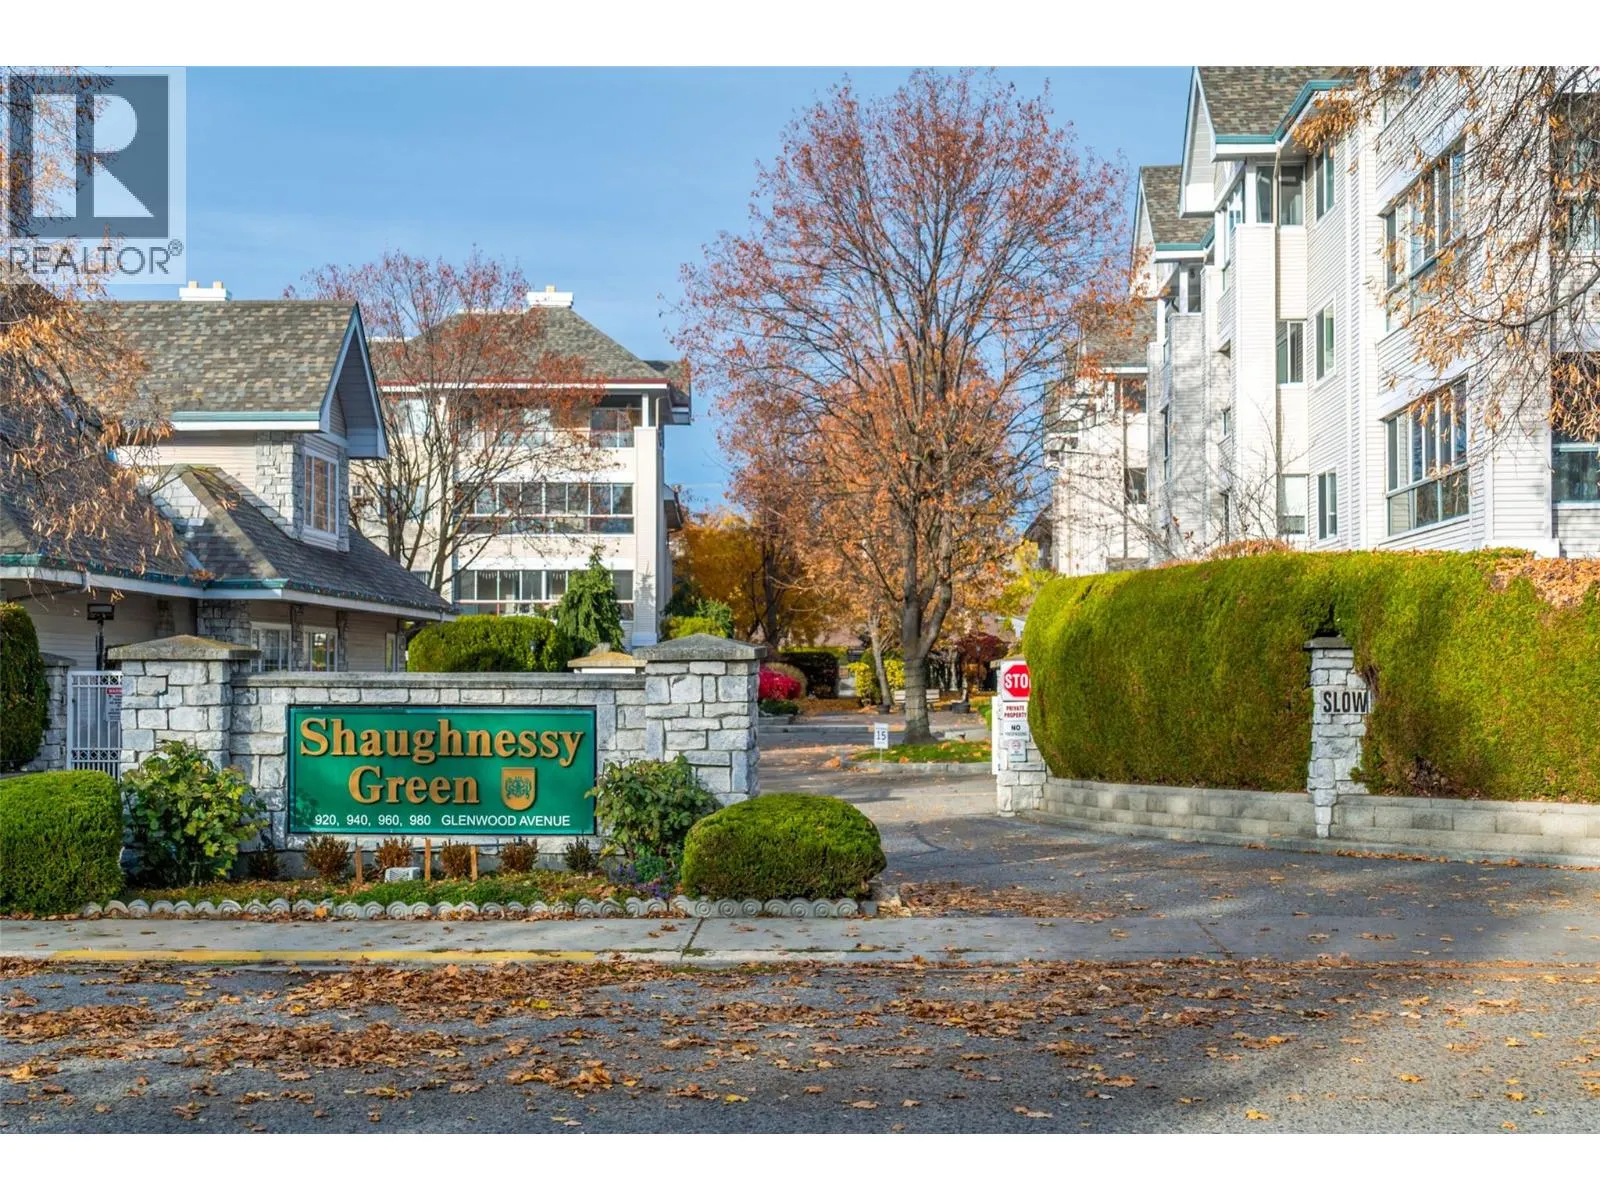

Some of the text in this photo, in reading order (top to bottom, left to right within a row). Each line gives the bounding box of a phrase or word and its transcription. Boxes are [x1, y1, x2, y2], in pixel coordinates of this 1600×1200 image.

[1005, 673, 1032, 689] STO
[1323, 691, 1369, 713] SLOW
[300, 717, 584, 767] Shaughnessy
[876, 730, 887, 741] 15
[348, 765, 480, 804] Green
[315, 814, 571, 827] 920, 940, 960, 980 GLENWOOD AVENUE
